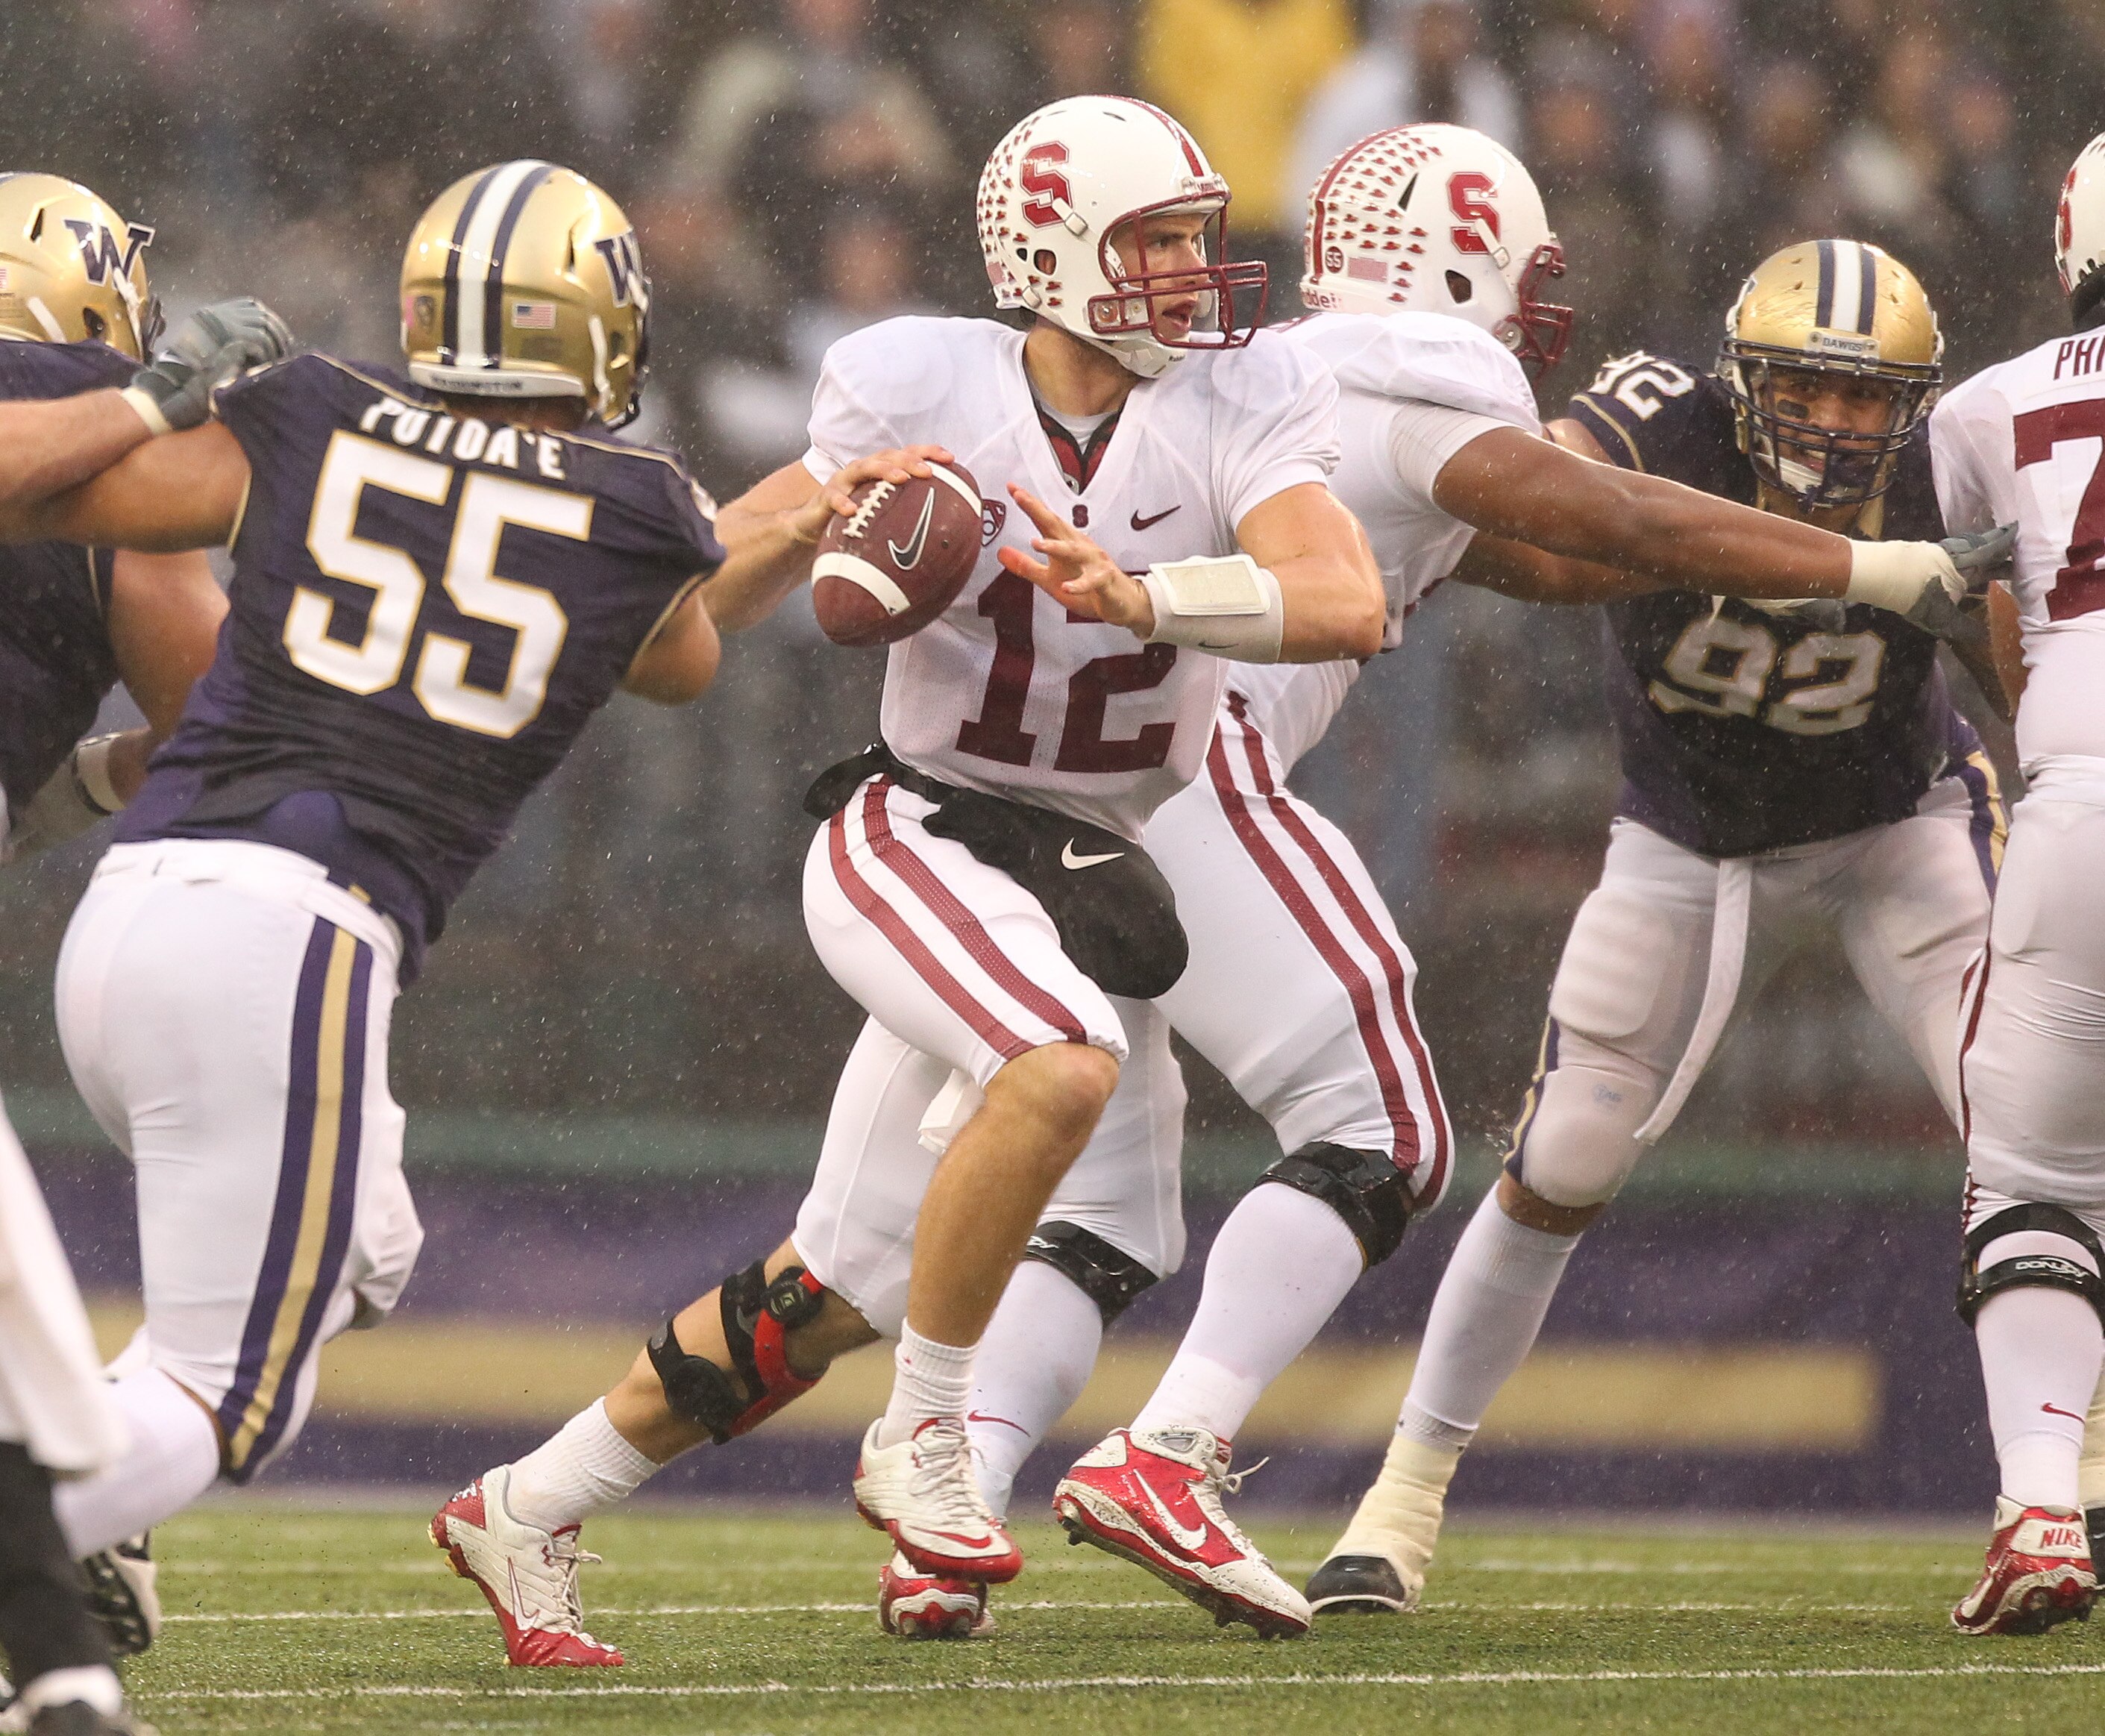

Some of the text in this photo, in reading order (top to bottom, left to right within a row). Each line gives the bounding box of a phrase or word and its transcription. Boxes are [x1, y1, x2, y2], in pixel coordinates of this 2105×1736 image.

[1020, 141, 1073, 228] S
[1446, 172, 1501, 255] S
[63, 219, 156, 289] W
[1326, 251, 1343, 269] 55
[1822, 337, 1863, 352] DAWGS
[1587, 350, 1696, 422] 92
[281, 428, 596, 740] 55
[956, 565, 1177, 774] 12
[1640, 613, 1887, 737] 92
[2039, 1527, 2083, 1549] NIKE
